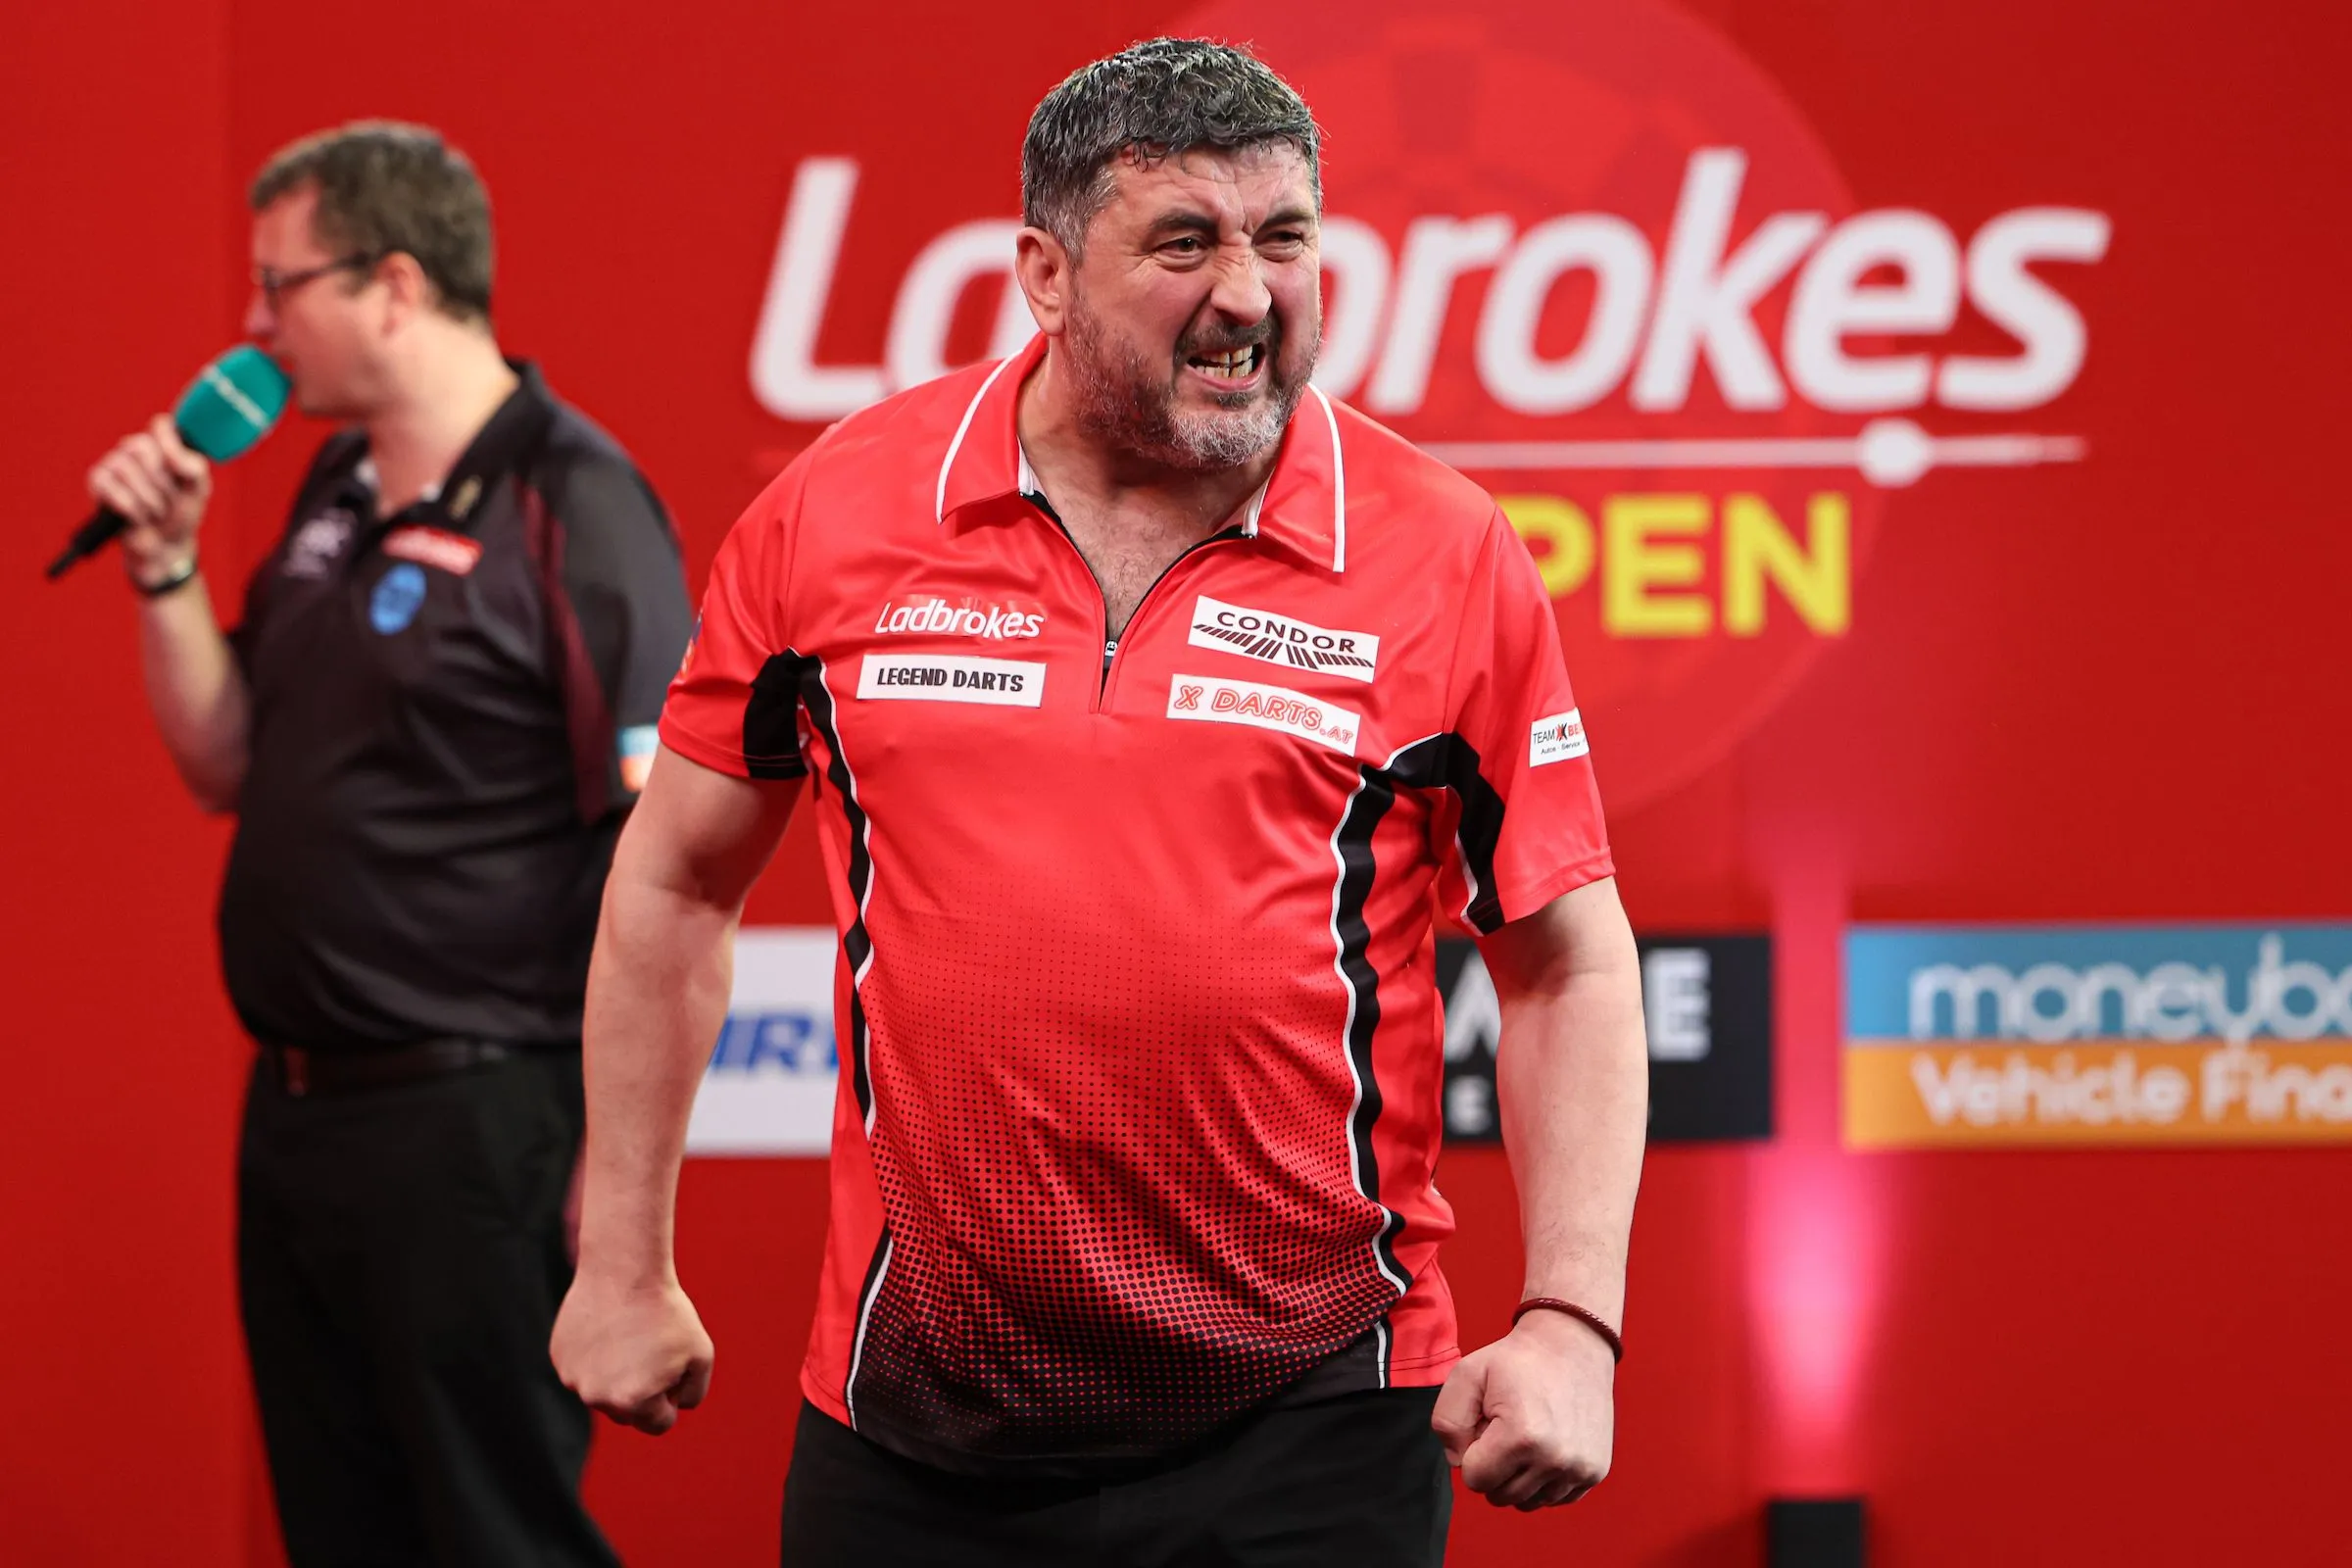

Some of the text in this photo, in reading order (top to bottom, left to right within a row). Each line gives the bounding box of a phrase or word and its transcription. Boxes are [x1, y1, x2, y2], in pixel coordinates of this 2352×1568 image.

[748, 147, 2112, 421] Larokes
[874, 599, 1045, 640] Ladbrokes
[1216, 611, 1356, 654] CONDOR
[877, 667, 1024, 692] LEGEND DARTS
[1175, 685, 1203, 710] X
[1907, 931, 2352, 1053] moneyb
[1910, 1051, 2191, 1124] Vehicle
